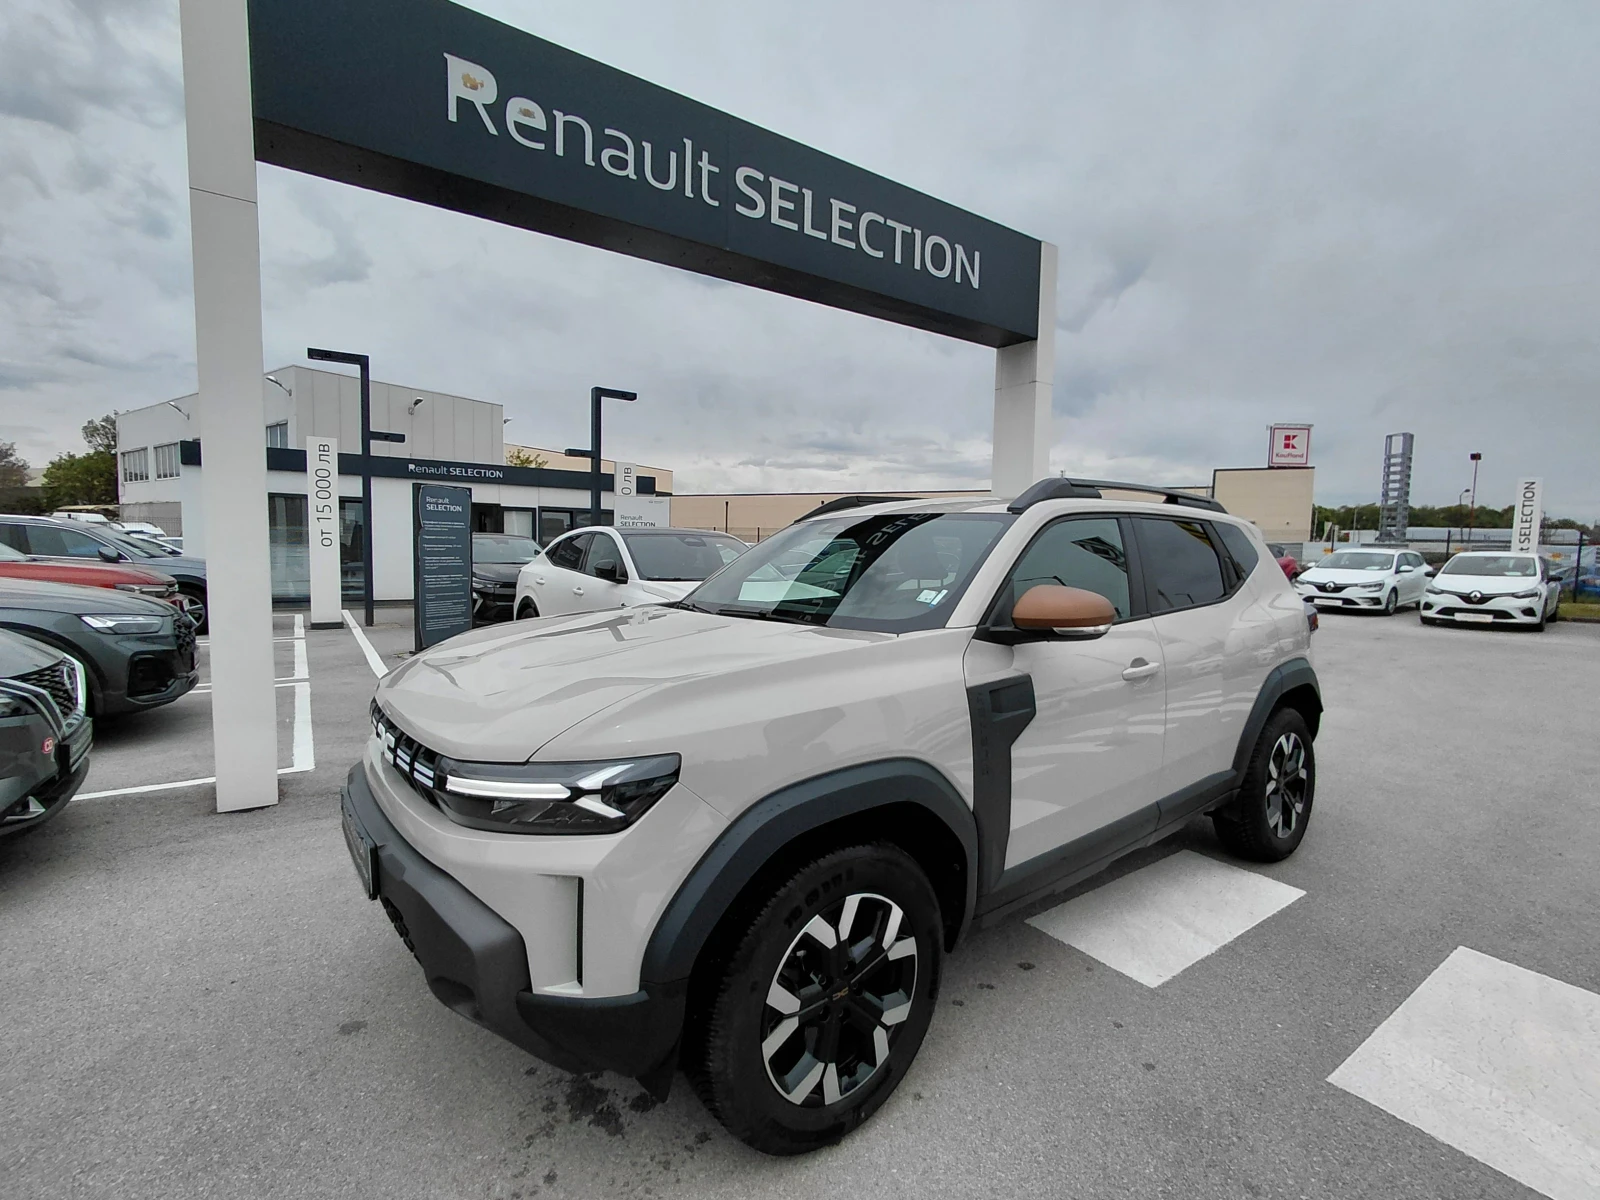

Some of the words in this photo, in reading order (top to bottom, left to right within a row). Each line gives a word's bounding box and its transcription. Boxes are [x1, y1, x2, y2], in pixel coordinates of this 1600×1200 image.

[443, 52, 719, 207] Renault
[735, 166, 980, 289] SELECTION
[408, 463, 447, 475] Renault
[449, 467, 503, 478] SELECTION
[314, 468, 332, 500] 000
[425, 496, 449, 504] Renault
[425, 503, 463, 512] SELECTION
[315, 504, 332, 523] 15
[1518, 481, 1536, 544] SELECTION
